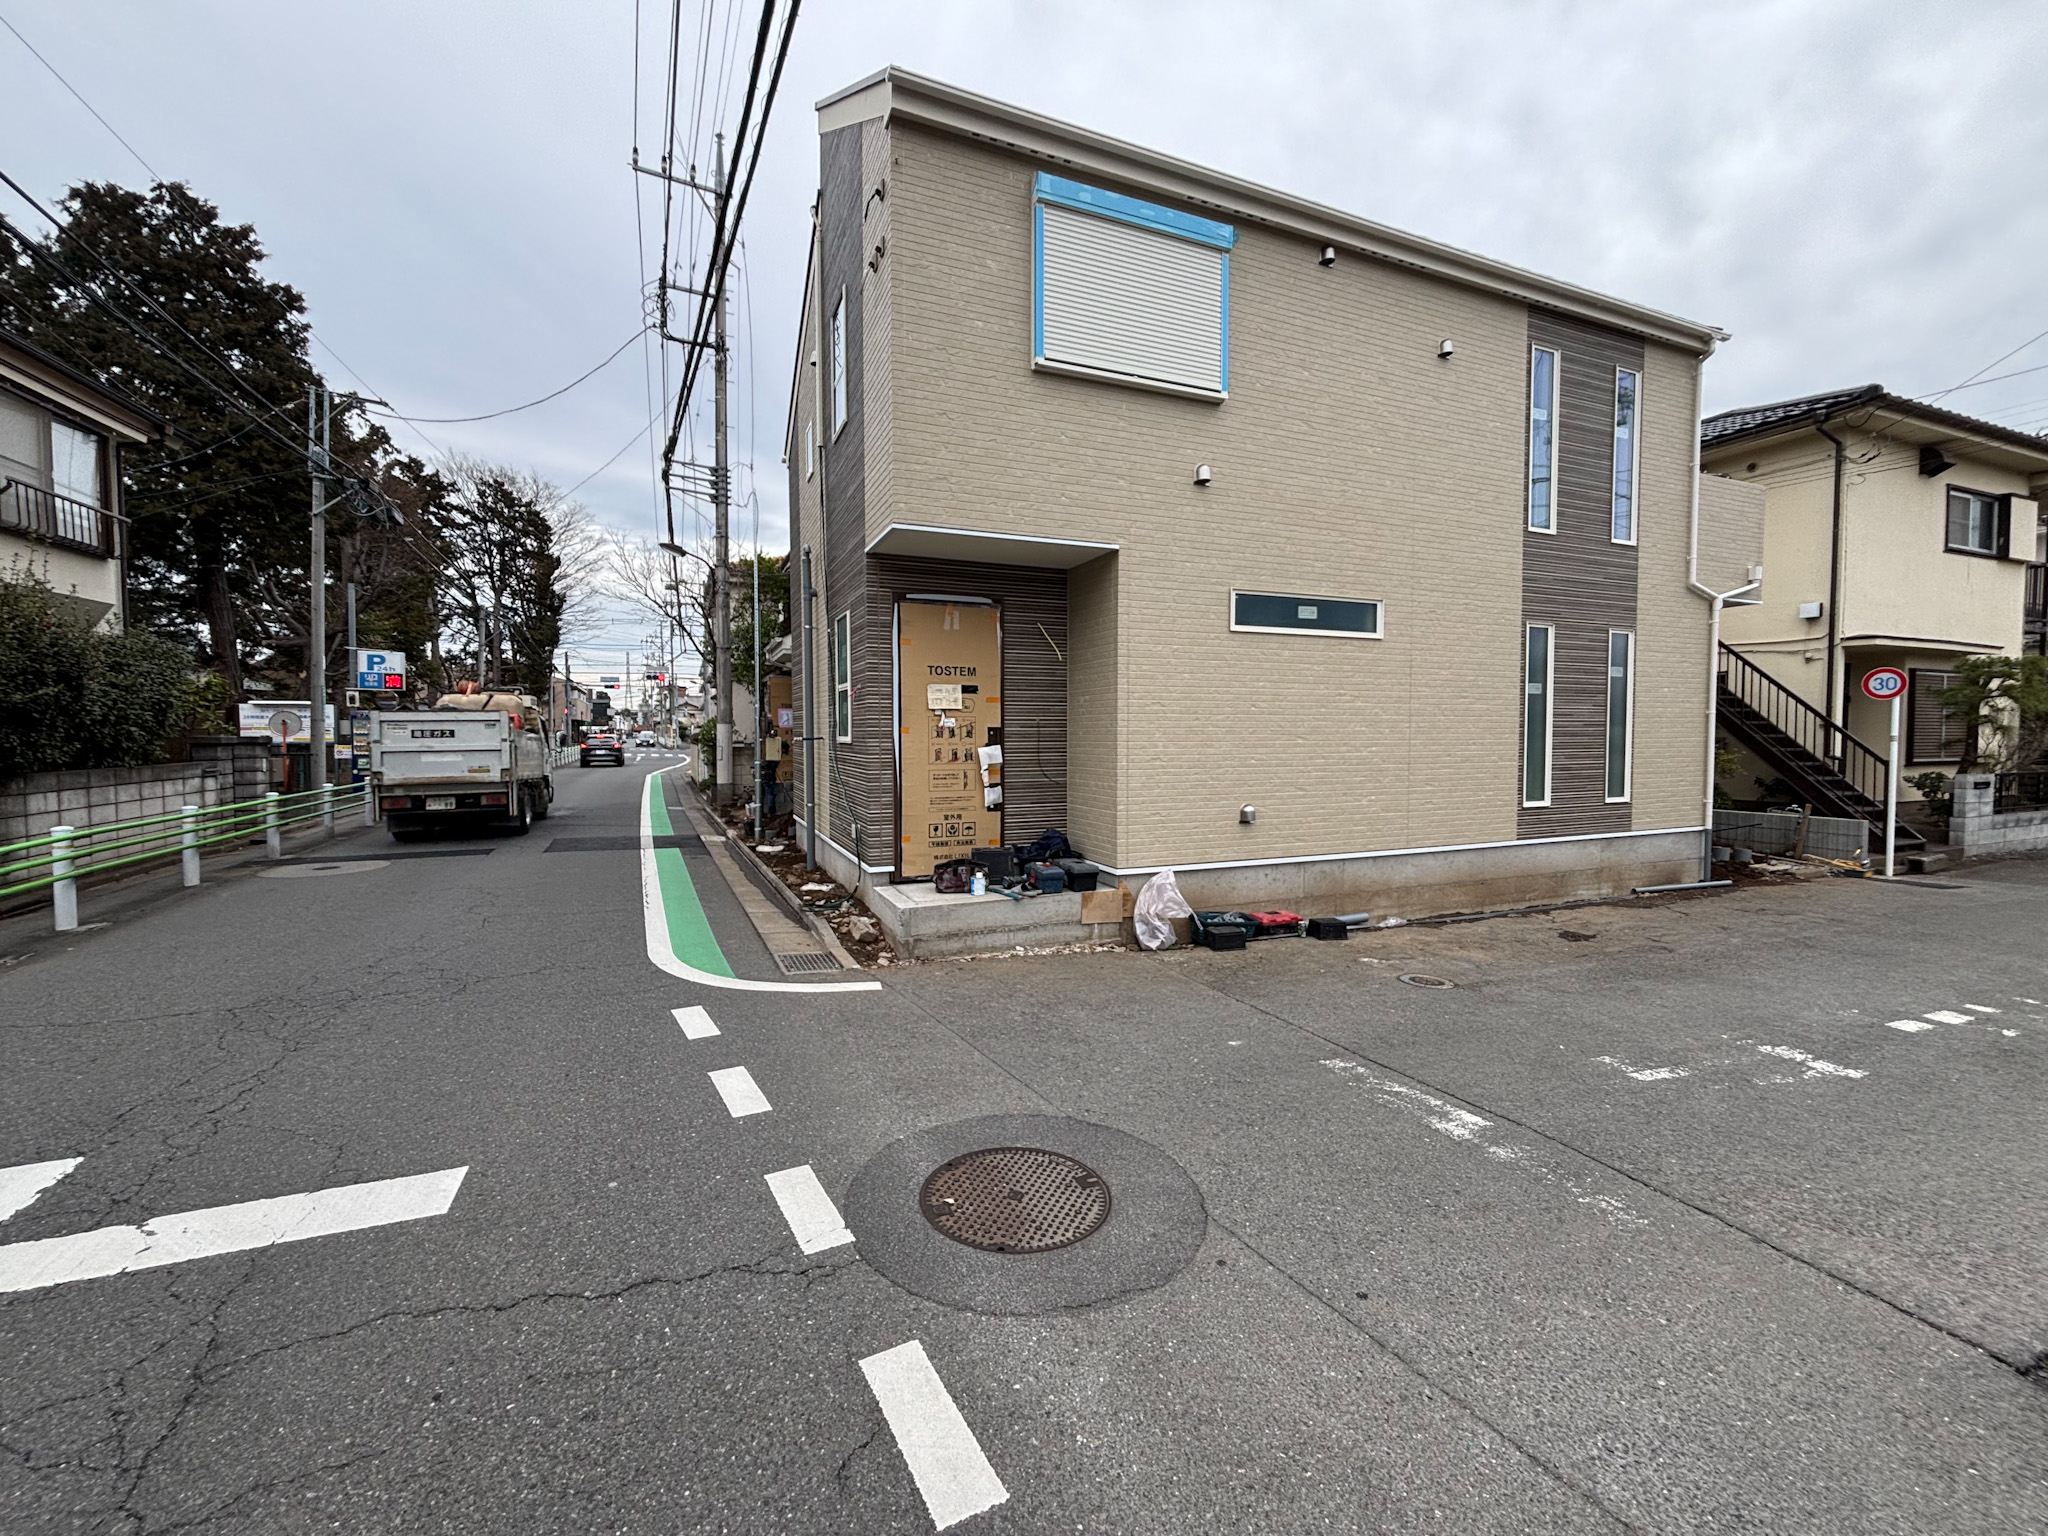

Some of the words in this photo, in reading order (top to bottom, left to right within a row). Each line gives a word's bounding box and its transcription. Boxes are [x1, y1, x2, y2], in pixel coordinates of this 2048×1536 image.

[367, 654, 386, 671] P
[927, 665, 976, 677] TOSTEM
[1873, 676, 1897, 691] 30
[412, 730, 453, 738] 高圧ガス
